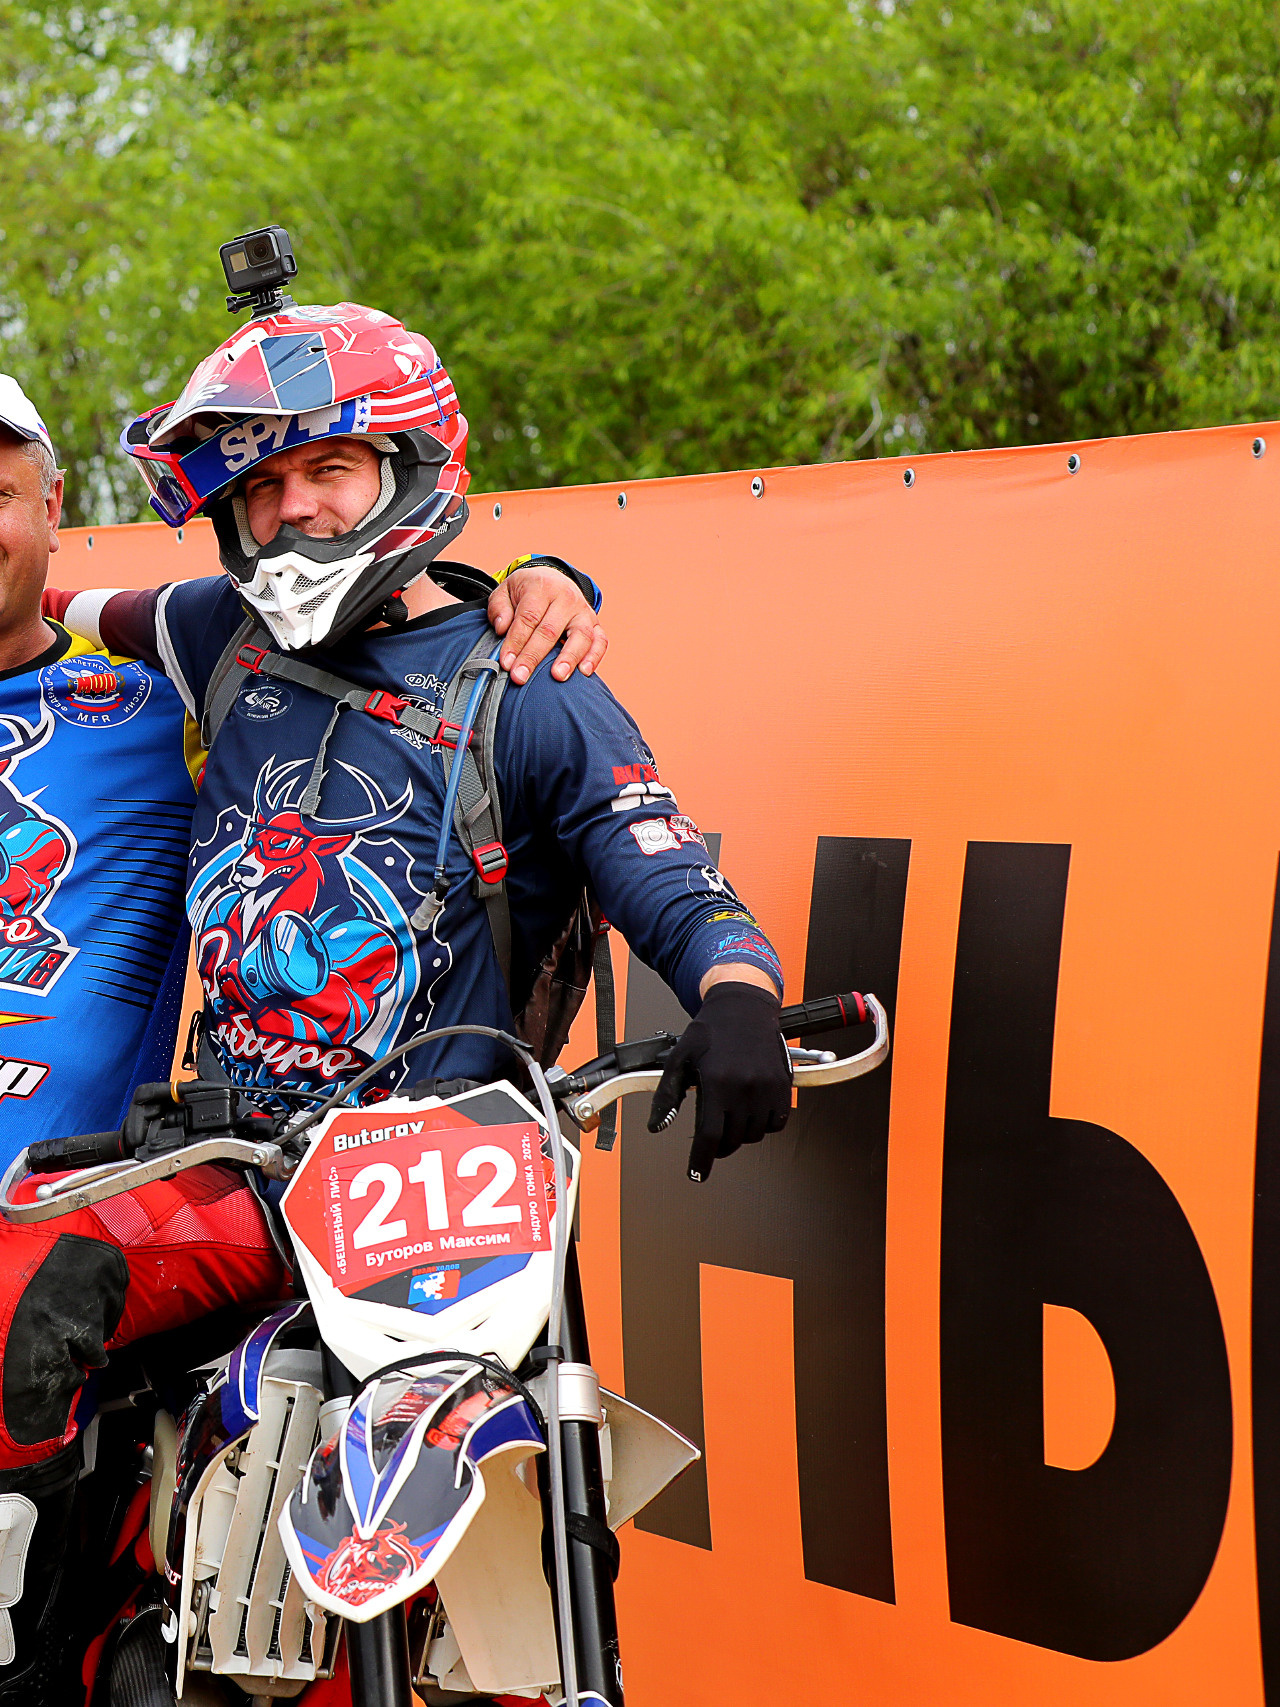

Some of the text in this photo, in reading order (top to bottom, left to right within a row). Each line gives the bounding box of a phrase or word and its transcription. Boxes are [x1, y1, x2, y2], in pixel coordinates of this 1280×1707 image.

[220, 414, 293, 472] SPY
[76, 712, 111, 724] MFR
[348, 1144, 523, 1250] 212
[365, 1231, 511, 1267] Буторов Максим
